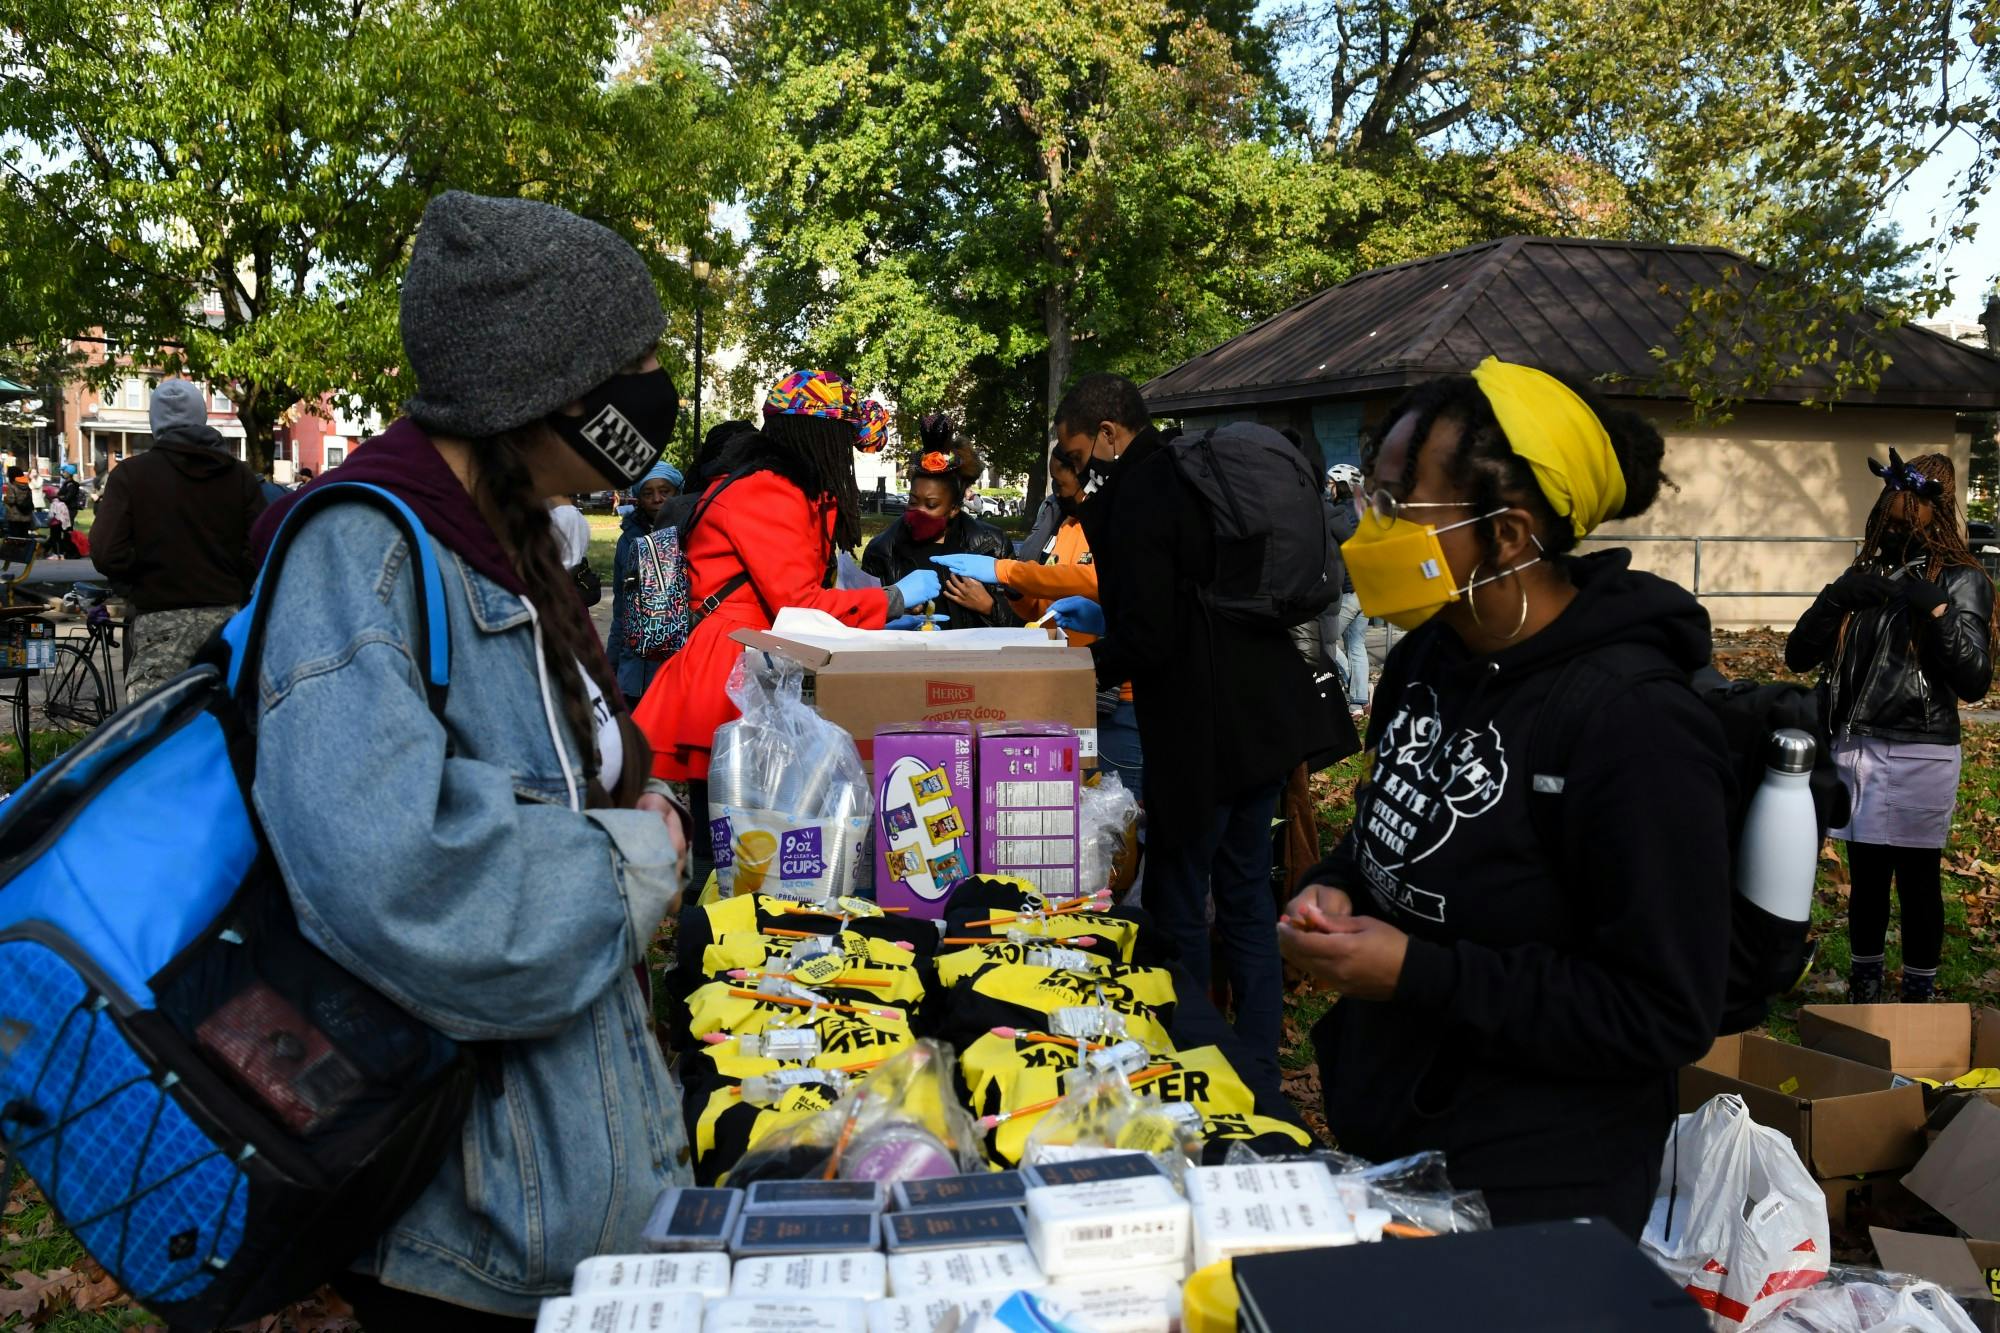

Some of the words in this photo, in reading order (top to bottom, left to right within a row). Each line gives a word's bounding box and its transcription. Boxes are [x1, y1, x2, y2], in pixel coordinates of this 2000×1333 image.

[931, 687, 970, 700] HERR'S
[974, 706, 1007, 721] GOOD
[959, 739, 970, 755] 28
[955, 761, 963, 786] TREATS
[962, 759, 970, 790] VARIETY
[1373, 799, 1403, 830] WEEK
[785, 836, 796, 853] 9
[1368, 816, 1408, 856] ACTION
[782, 860, 822, 875] CUPS
